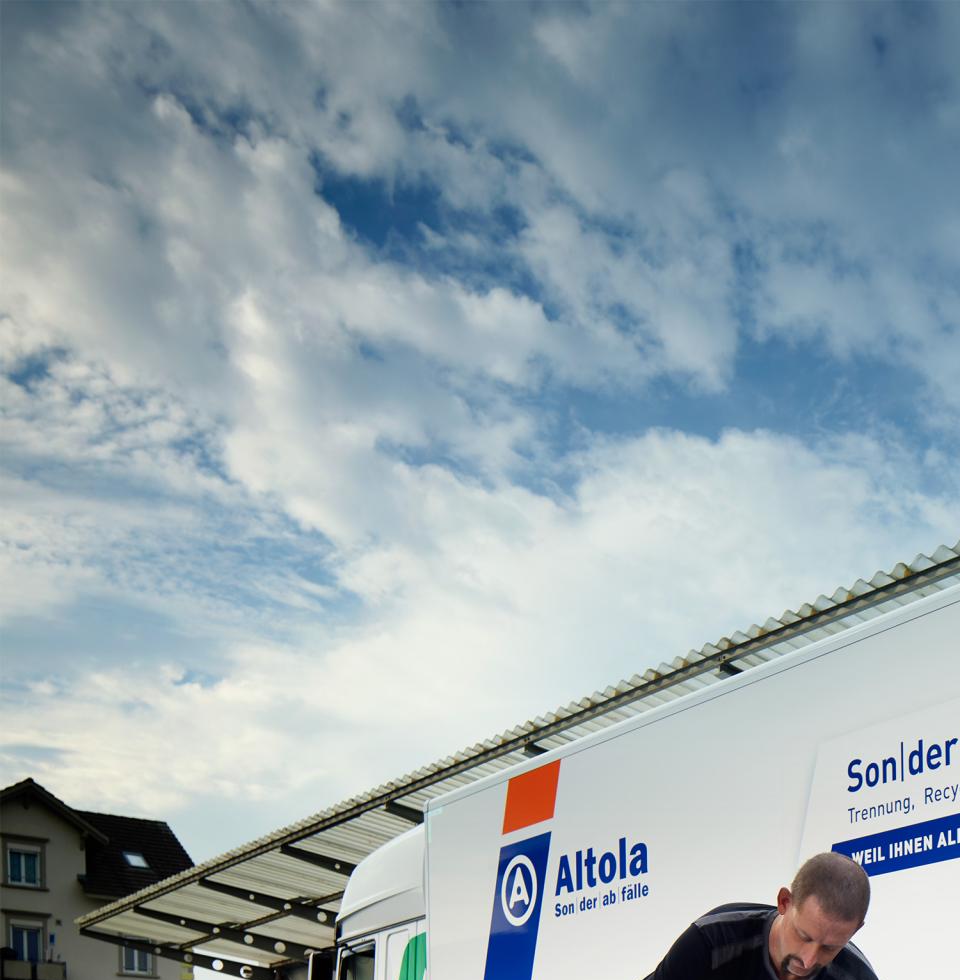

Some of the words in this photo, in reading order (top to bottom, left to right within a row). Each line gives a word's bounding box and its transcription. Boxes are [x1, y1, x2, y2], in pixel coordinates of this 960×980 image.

[848, 797, 915, 824] Trennung,
[555, 837, 648, 896] Altola
[852, 846, 886, 867] WEIL
[889, 834, 933, 859] IHNEN
[554, 902, 575, 918] Son
[579, 896, 598, 912] der
[602, 889, 617, 906] ab
[621, 882, 649, 901] fälle
